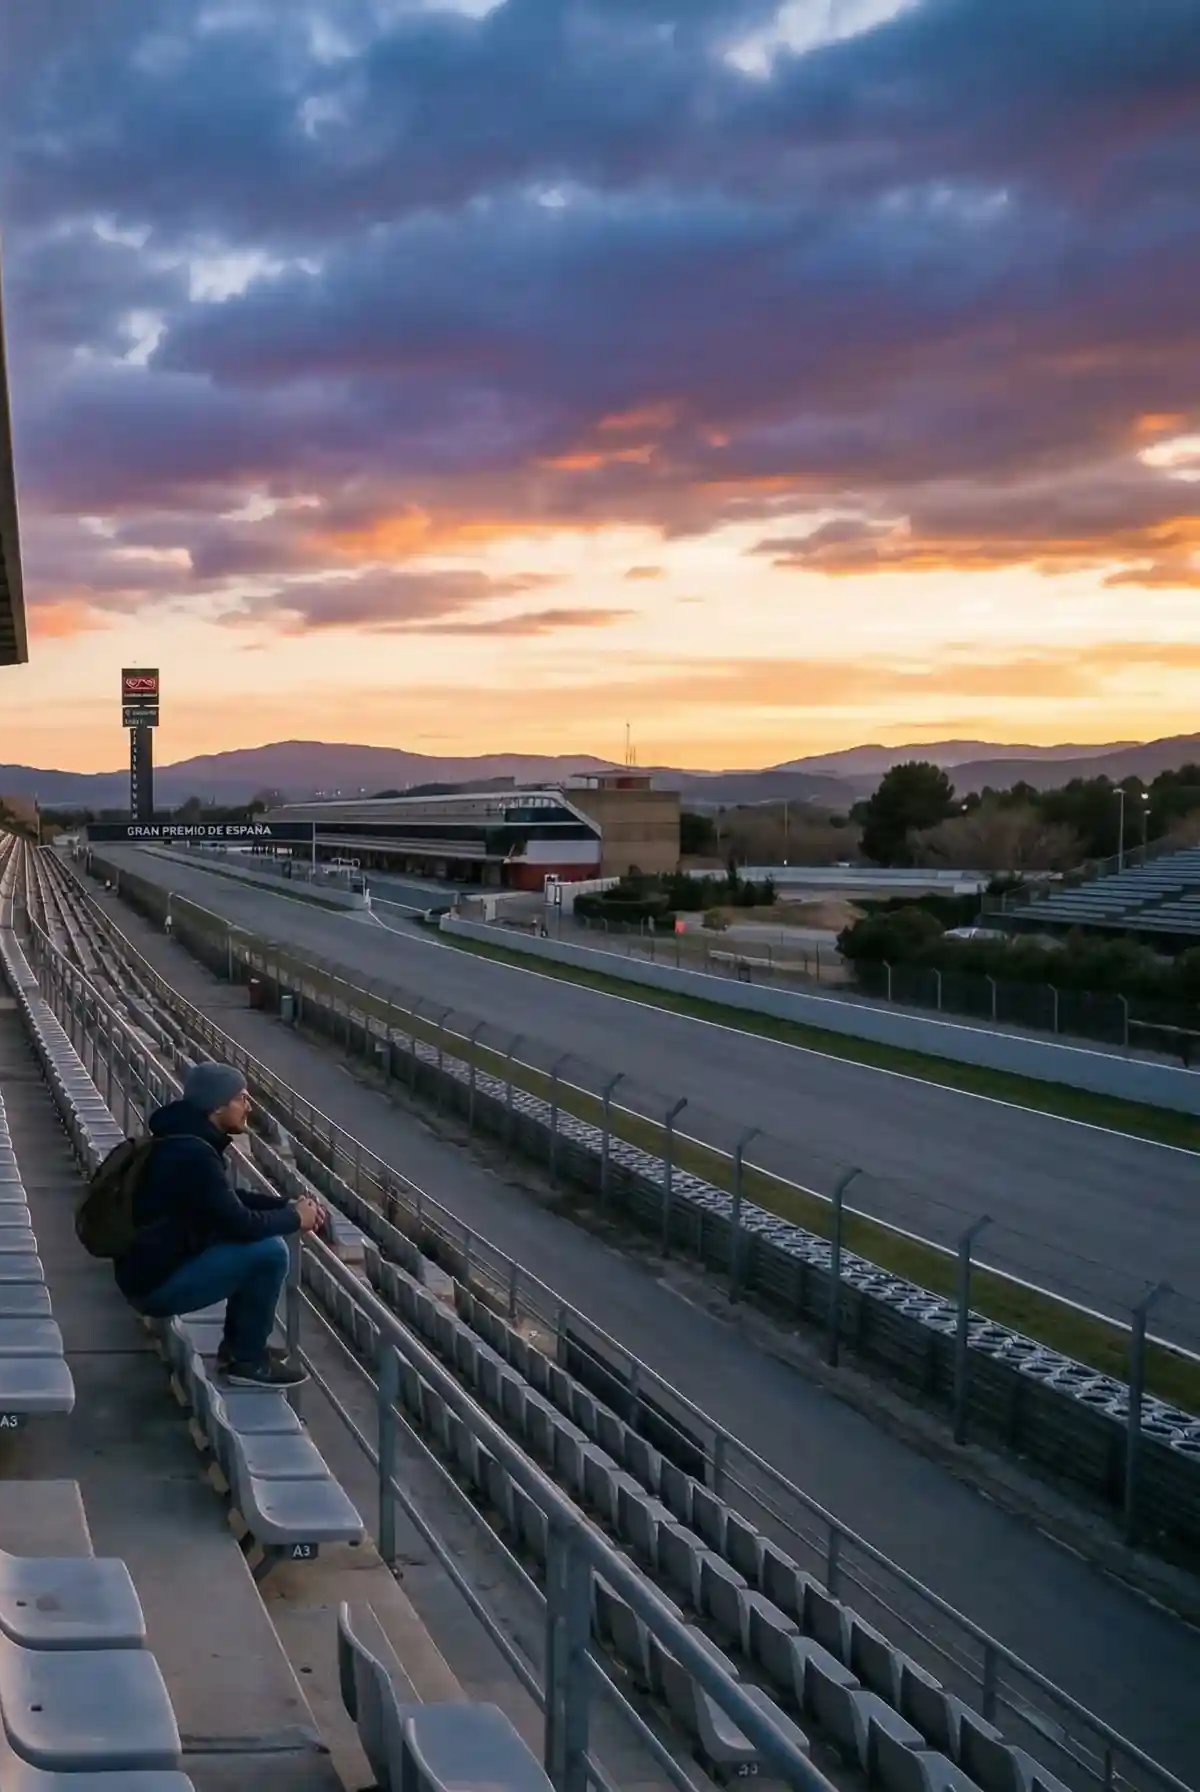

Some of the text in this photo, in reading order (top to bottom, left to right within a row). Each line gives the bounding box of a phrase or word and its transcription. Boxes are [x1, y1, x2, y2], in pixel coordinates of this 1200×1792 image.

[127, 822, 272, 836] GRAN PREMIO DE ESPAÑA
[0, 1415, 18, 1428] A3
[292, 1544, 310, 1558] A3
